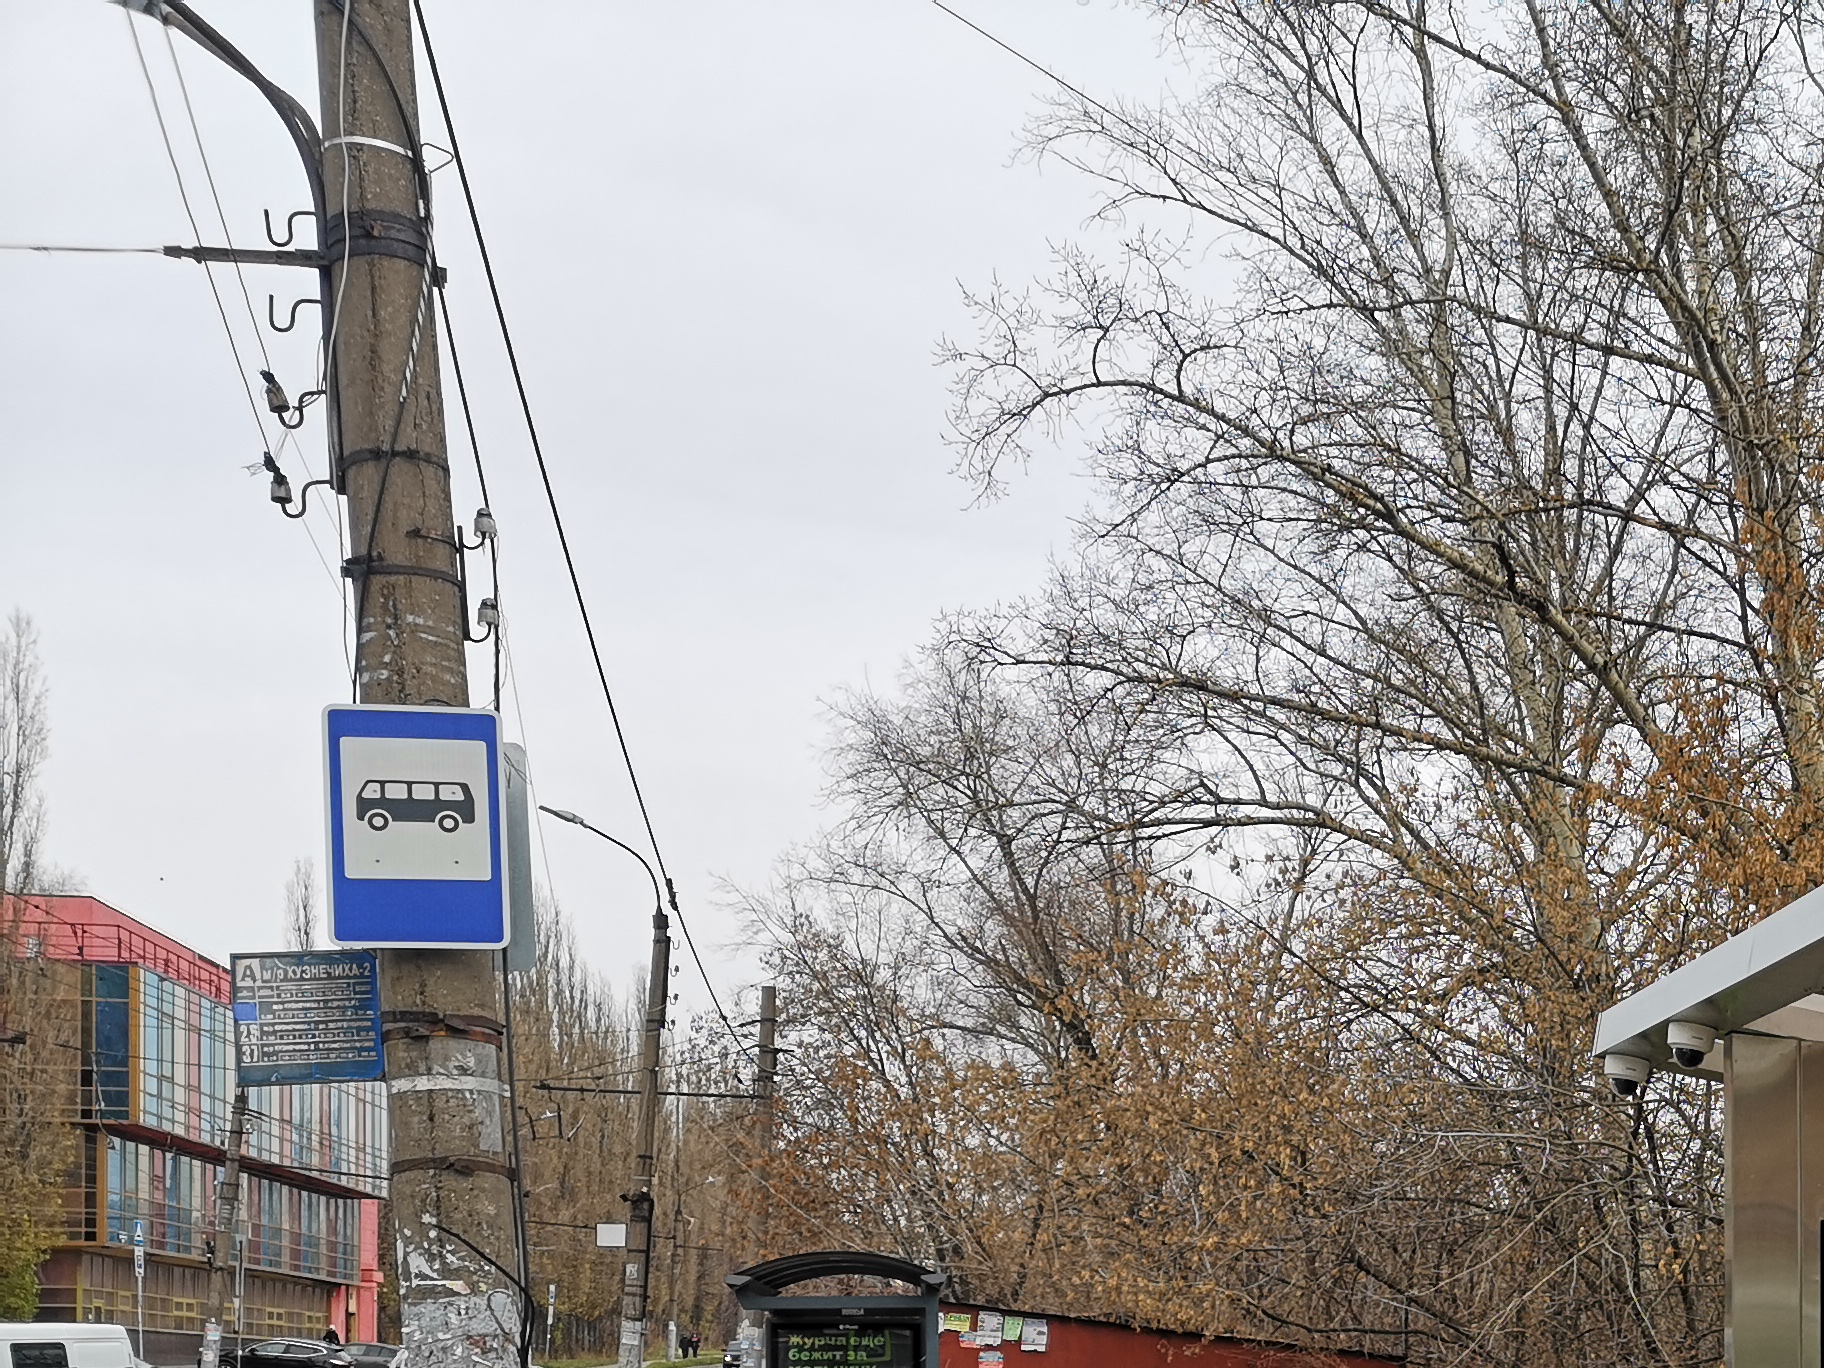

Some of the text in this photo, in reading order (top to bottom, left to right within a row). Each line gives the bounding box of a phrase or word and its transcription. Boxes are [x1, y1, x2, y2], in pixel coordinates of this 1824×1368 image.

[262, 967, 284, 983] м/р
[241, 1045, 259, 1063] 37
[788, 1334, 847, 1349] Журча
[788, 1348, 868, 1360] бежит за
